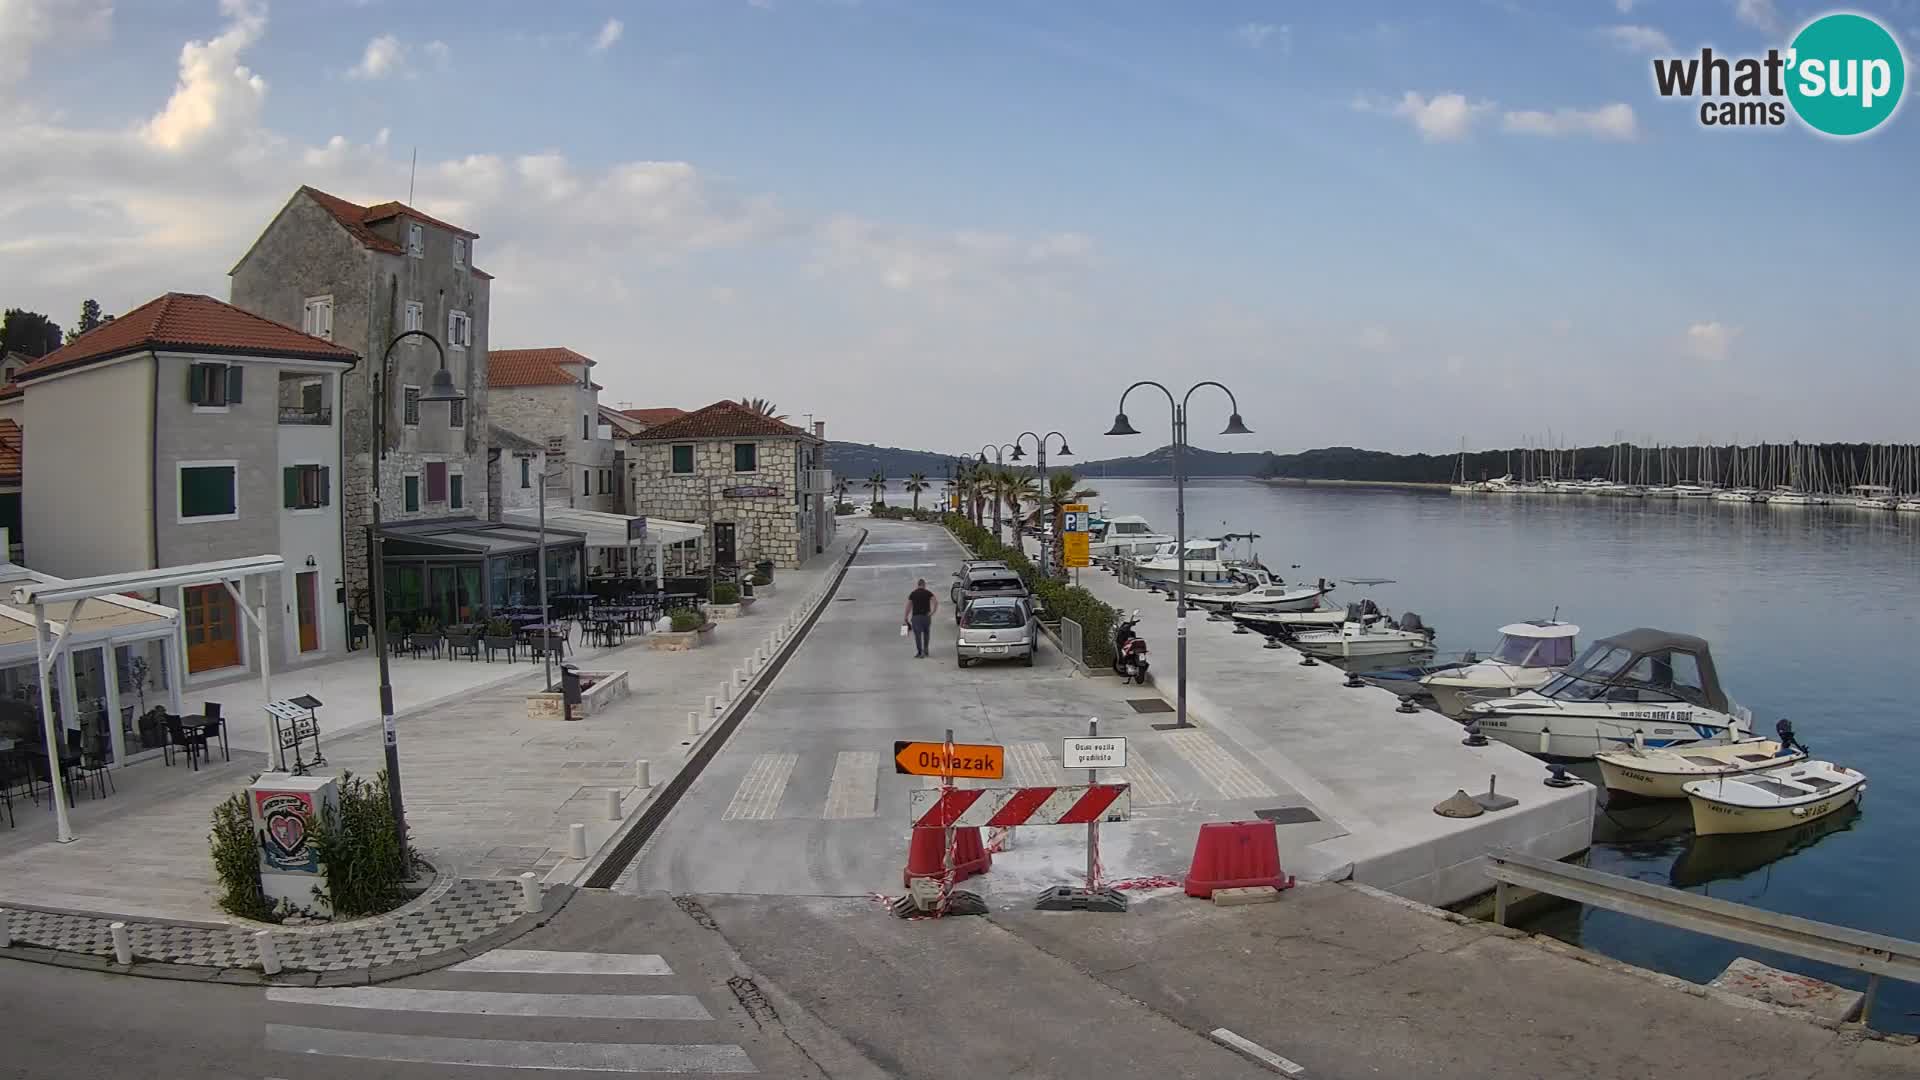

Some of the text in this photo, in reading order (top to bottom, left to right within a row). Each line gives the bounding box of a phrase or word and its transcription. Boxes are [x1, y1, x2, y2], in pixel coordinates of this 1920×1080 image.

[1065, 514, 1076, 530] P
[1652, 711, 1670, 720] RENT
[1670, 711, 1676, 720] A
[1676, 711, 1694, 721] BOAT
